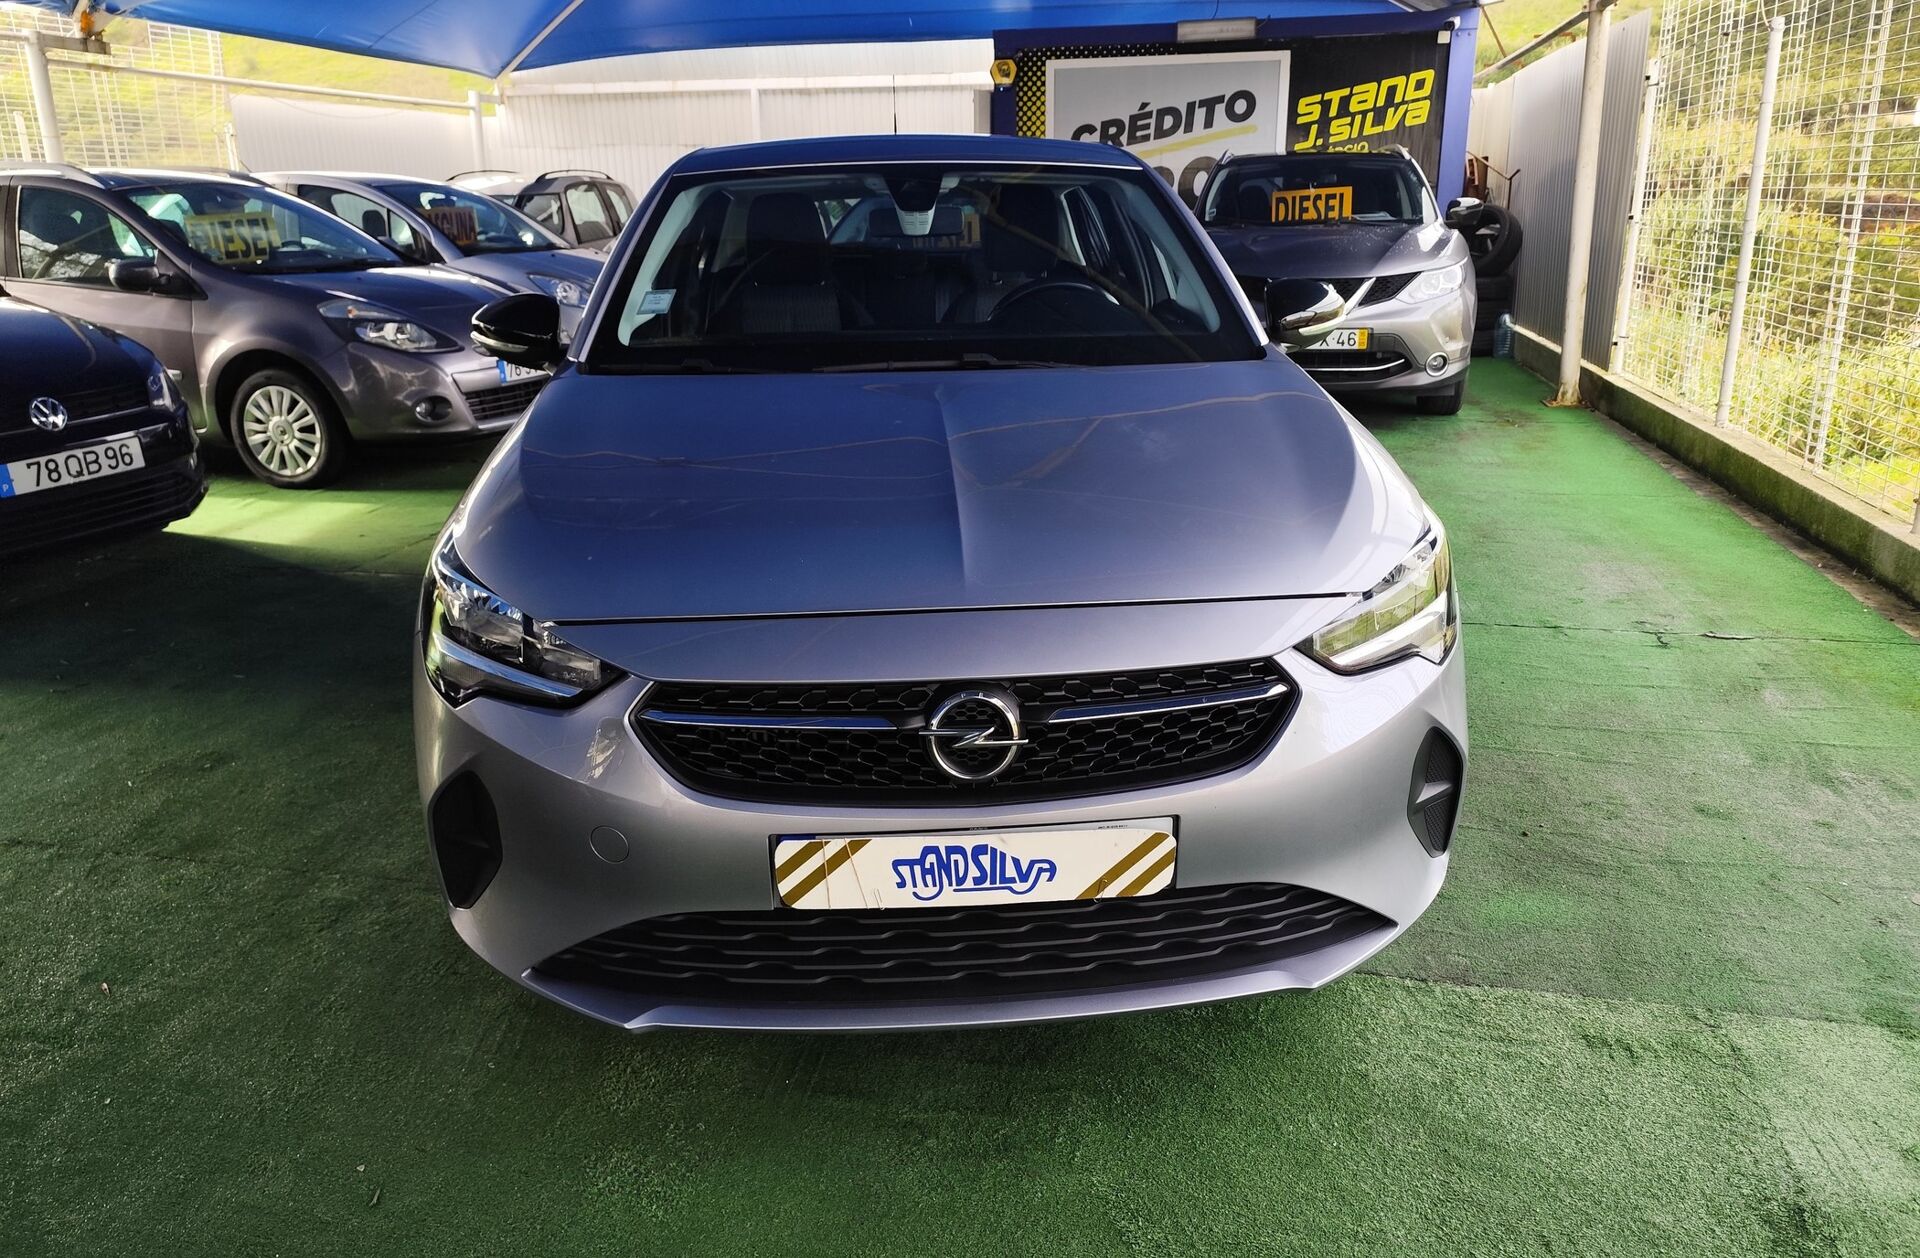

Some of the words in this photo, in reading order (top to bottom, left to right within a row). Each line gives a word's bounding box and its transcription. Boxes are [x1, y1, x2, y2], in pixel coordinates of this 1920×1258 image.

[1293, 123, 1324, 151] J.
[1274, 192, 1350, 223] DIESEL
[190, 217, 272, 259] IESEL
